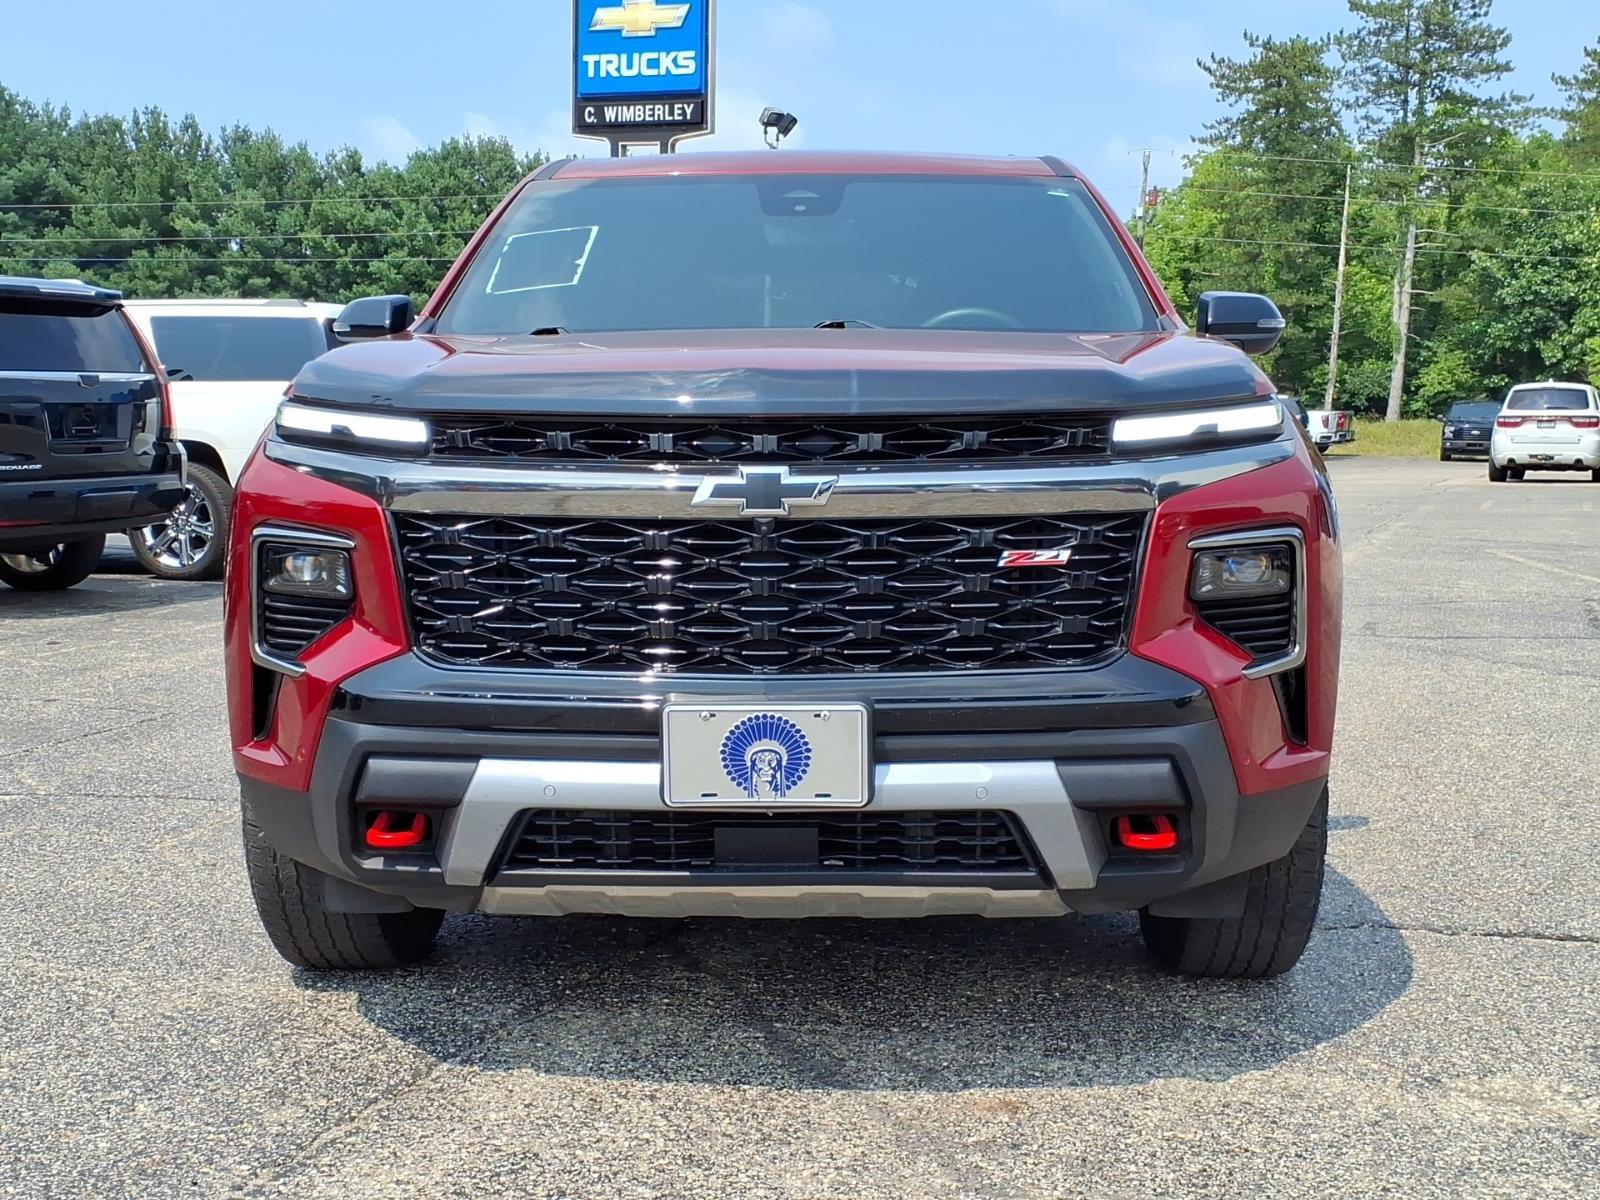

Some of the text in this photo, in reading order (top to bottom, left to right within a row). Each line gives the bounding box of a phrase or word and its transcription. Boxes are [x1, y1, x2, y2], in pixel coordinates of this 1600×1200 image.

[582, 50, 696, 78] TRUCKS
[584, 103, 694, 123] C. WIMBERLEY
[997, 549, 1072, 568] Z71
